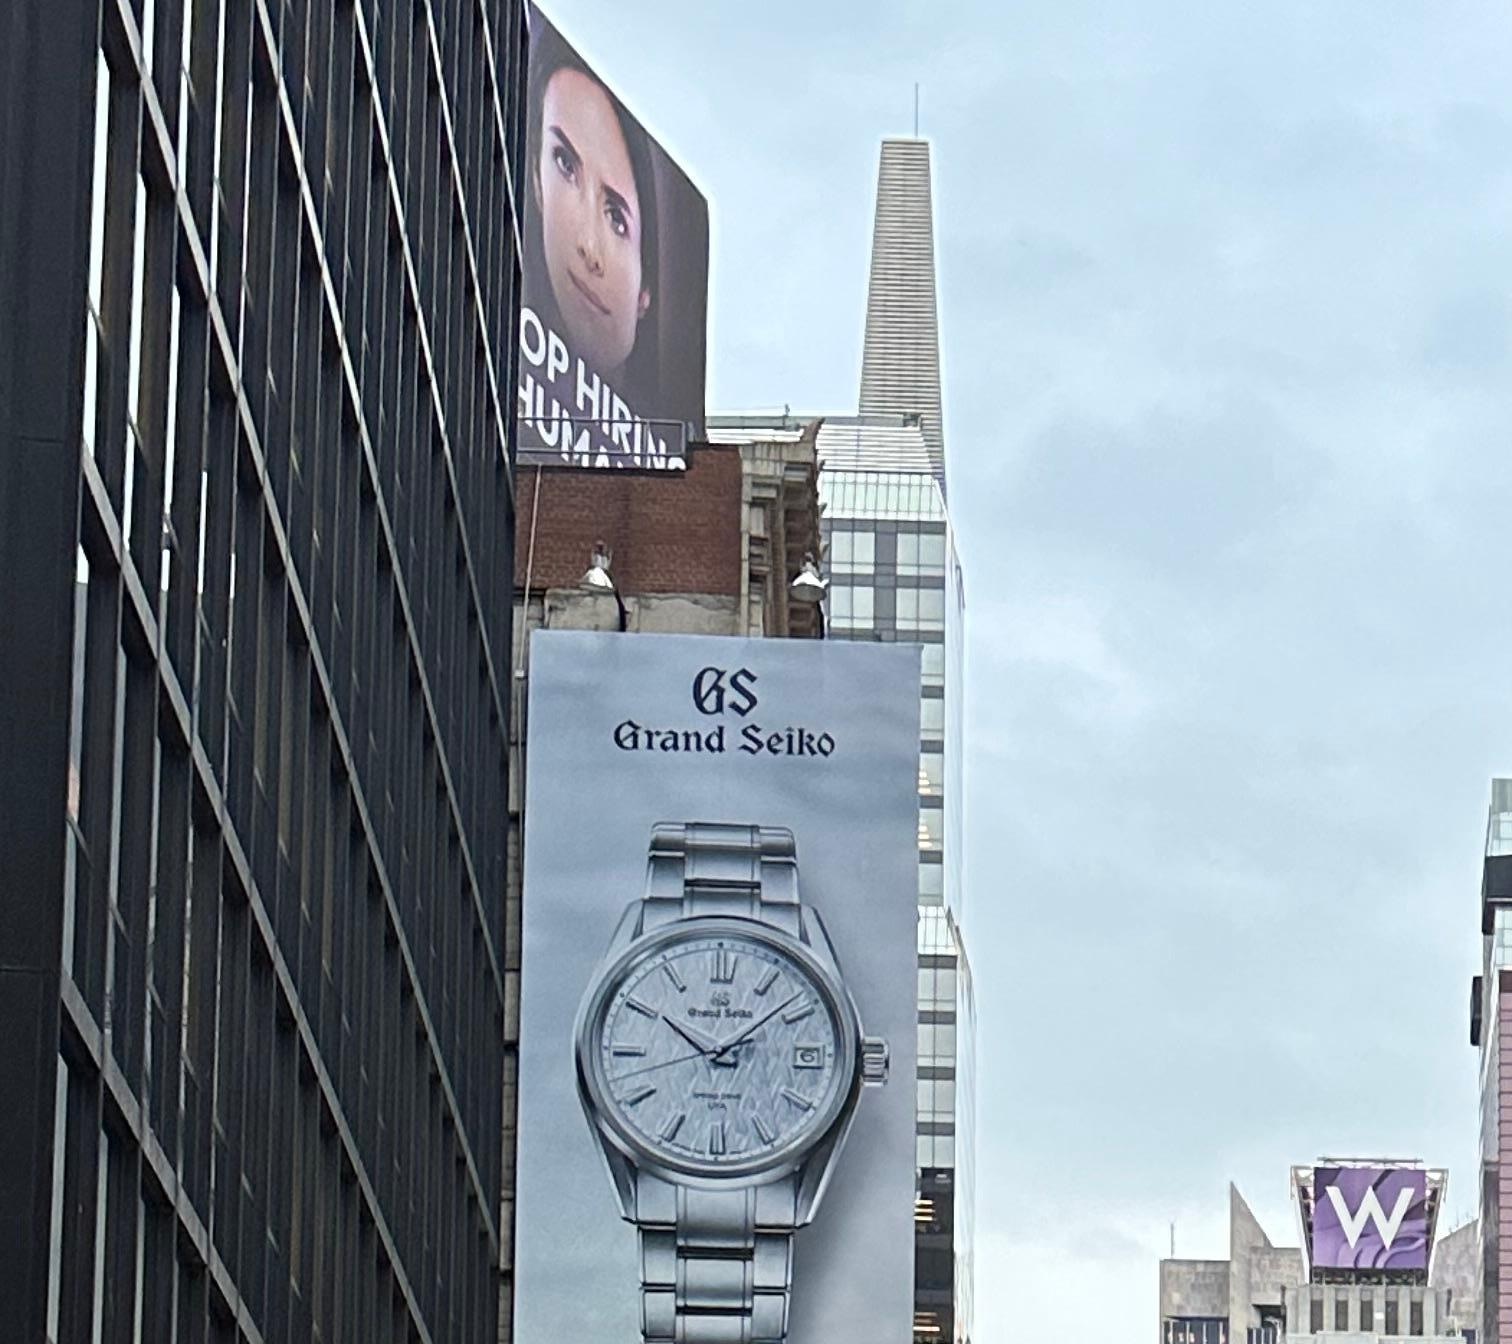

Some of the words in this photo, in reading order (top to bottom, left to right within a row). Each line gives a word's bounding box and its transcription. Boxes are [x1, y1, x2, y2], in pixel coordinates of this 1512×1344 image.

[520, 308, 569, 382] OP
[576, 358, 686, 470] HIRIN
[614, 720, 725, 753] Grand
[738, 724, 835, 757] Seiko
[1325, 1186, 1415, 1250] W
